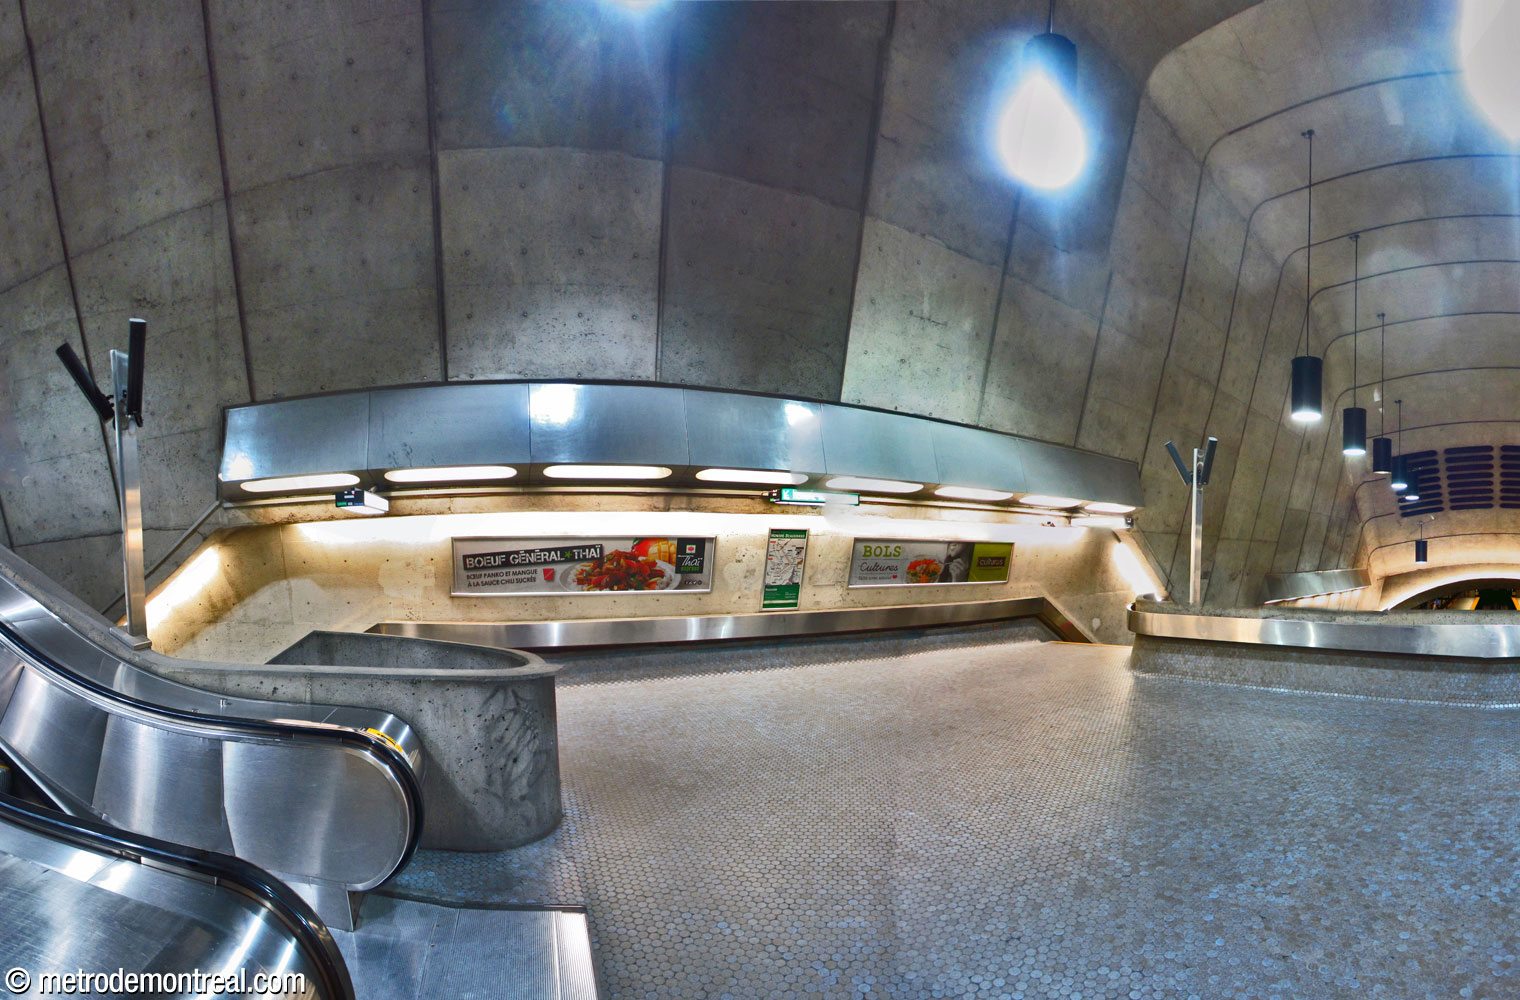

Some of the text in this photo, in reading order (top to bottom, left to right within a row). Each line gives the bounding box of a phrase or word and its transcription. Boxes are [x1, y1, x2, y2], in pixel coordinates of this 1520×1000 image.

[509, 549, 565, 564] GÉNÉRAL
[573, 545, 601, 560] THAÏ
[862, 544, 902, 558] BOLS
[860, 561, 899, 572] Cultures
